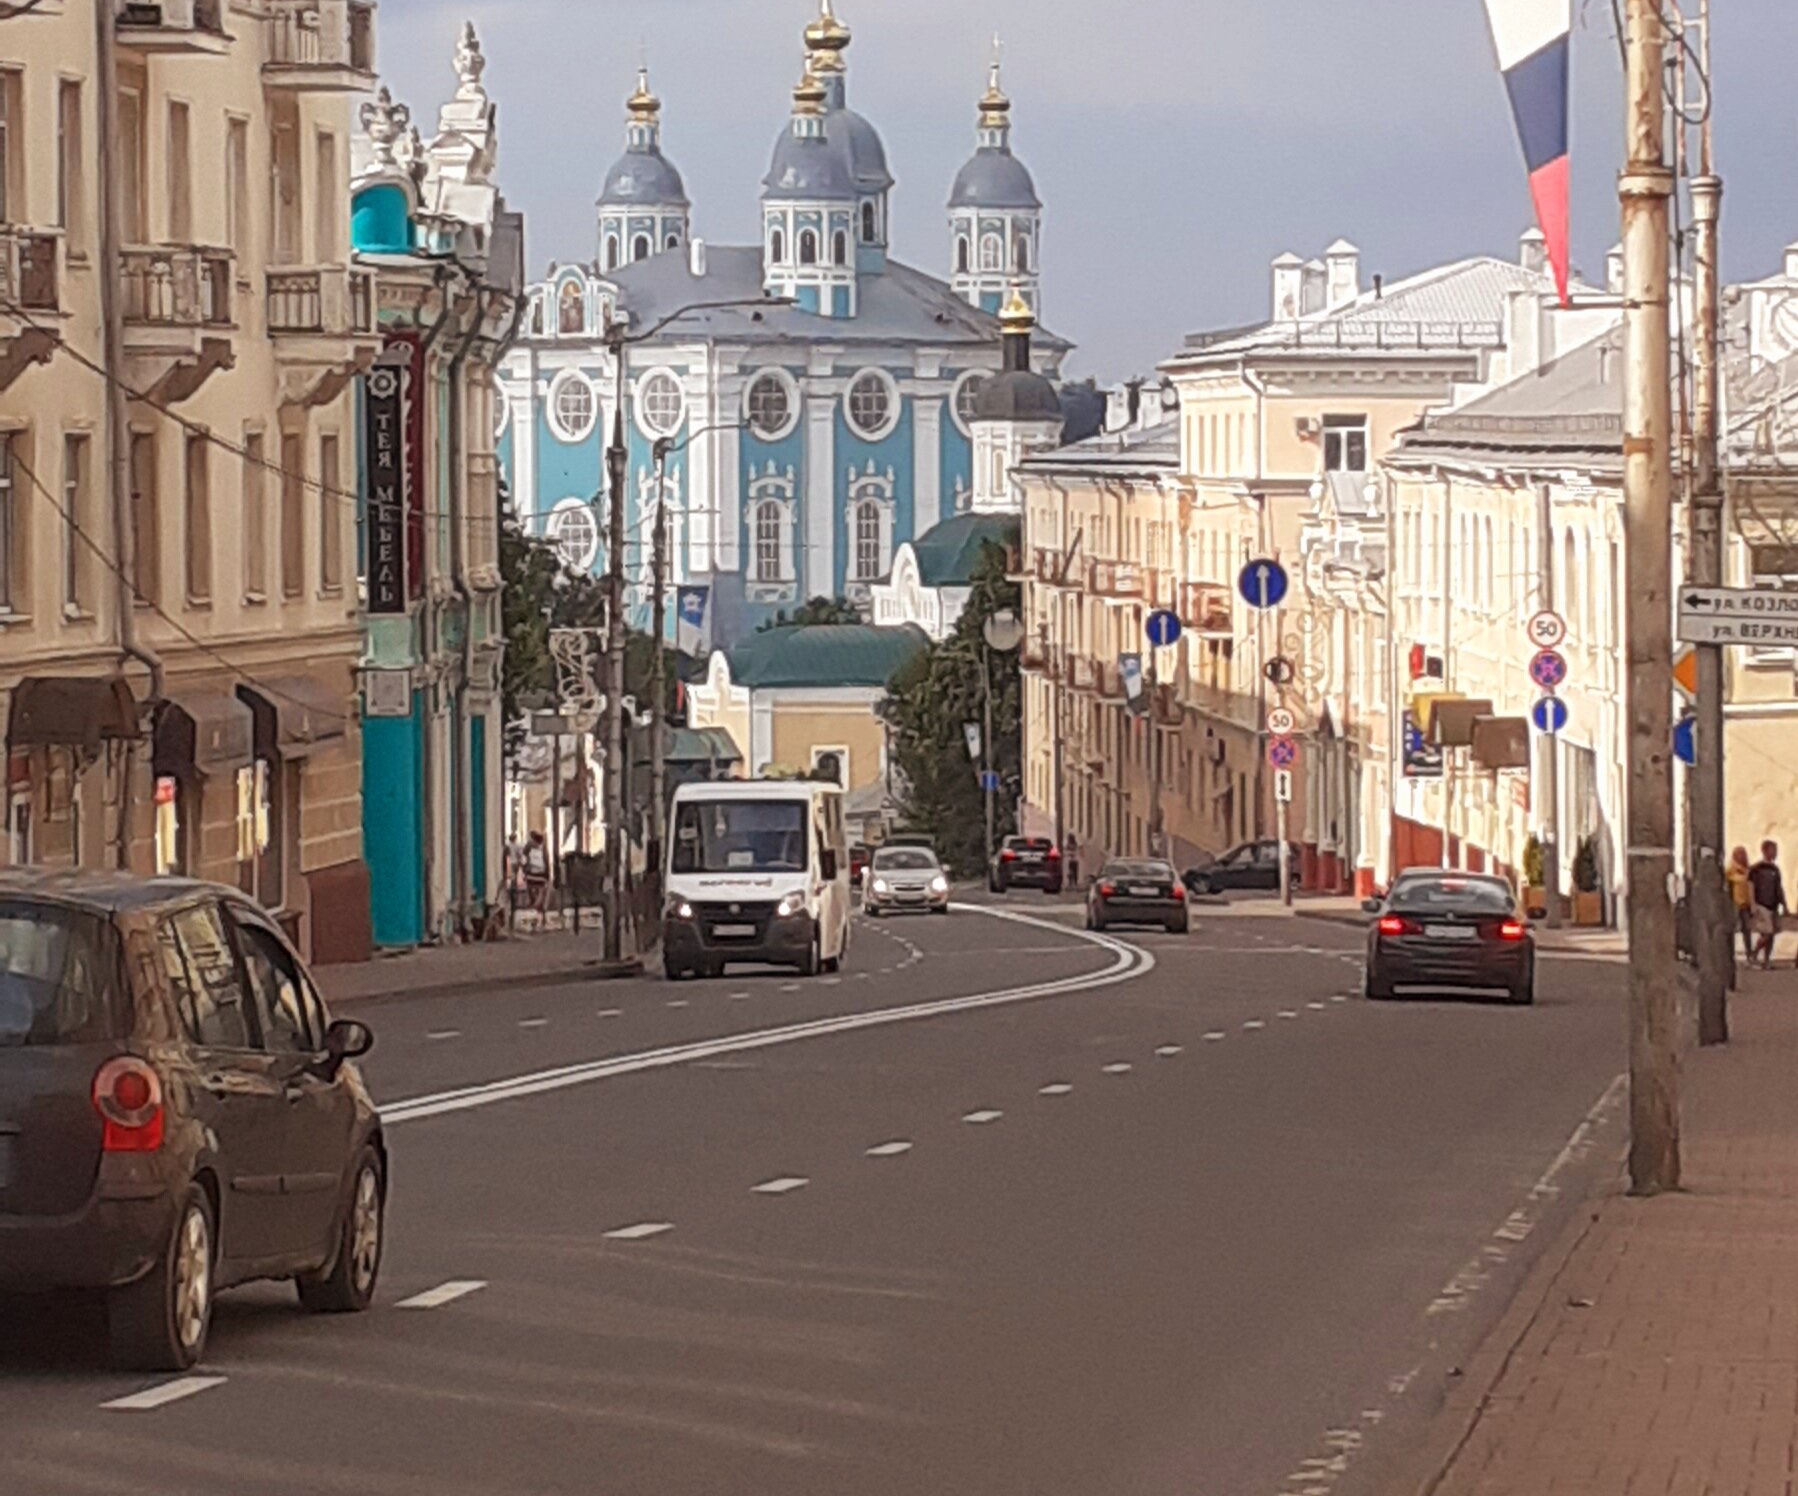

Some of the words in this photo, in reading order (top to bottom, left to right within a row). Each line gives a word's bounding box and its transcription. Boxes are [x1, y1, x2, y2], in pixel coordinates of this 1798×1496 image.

[377, 485, 394, 602] МЕБЕЛЬ
[1536, 620, 1557, 636] 50
[1273, 714, 1290, 728] 50
